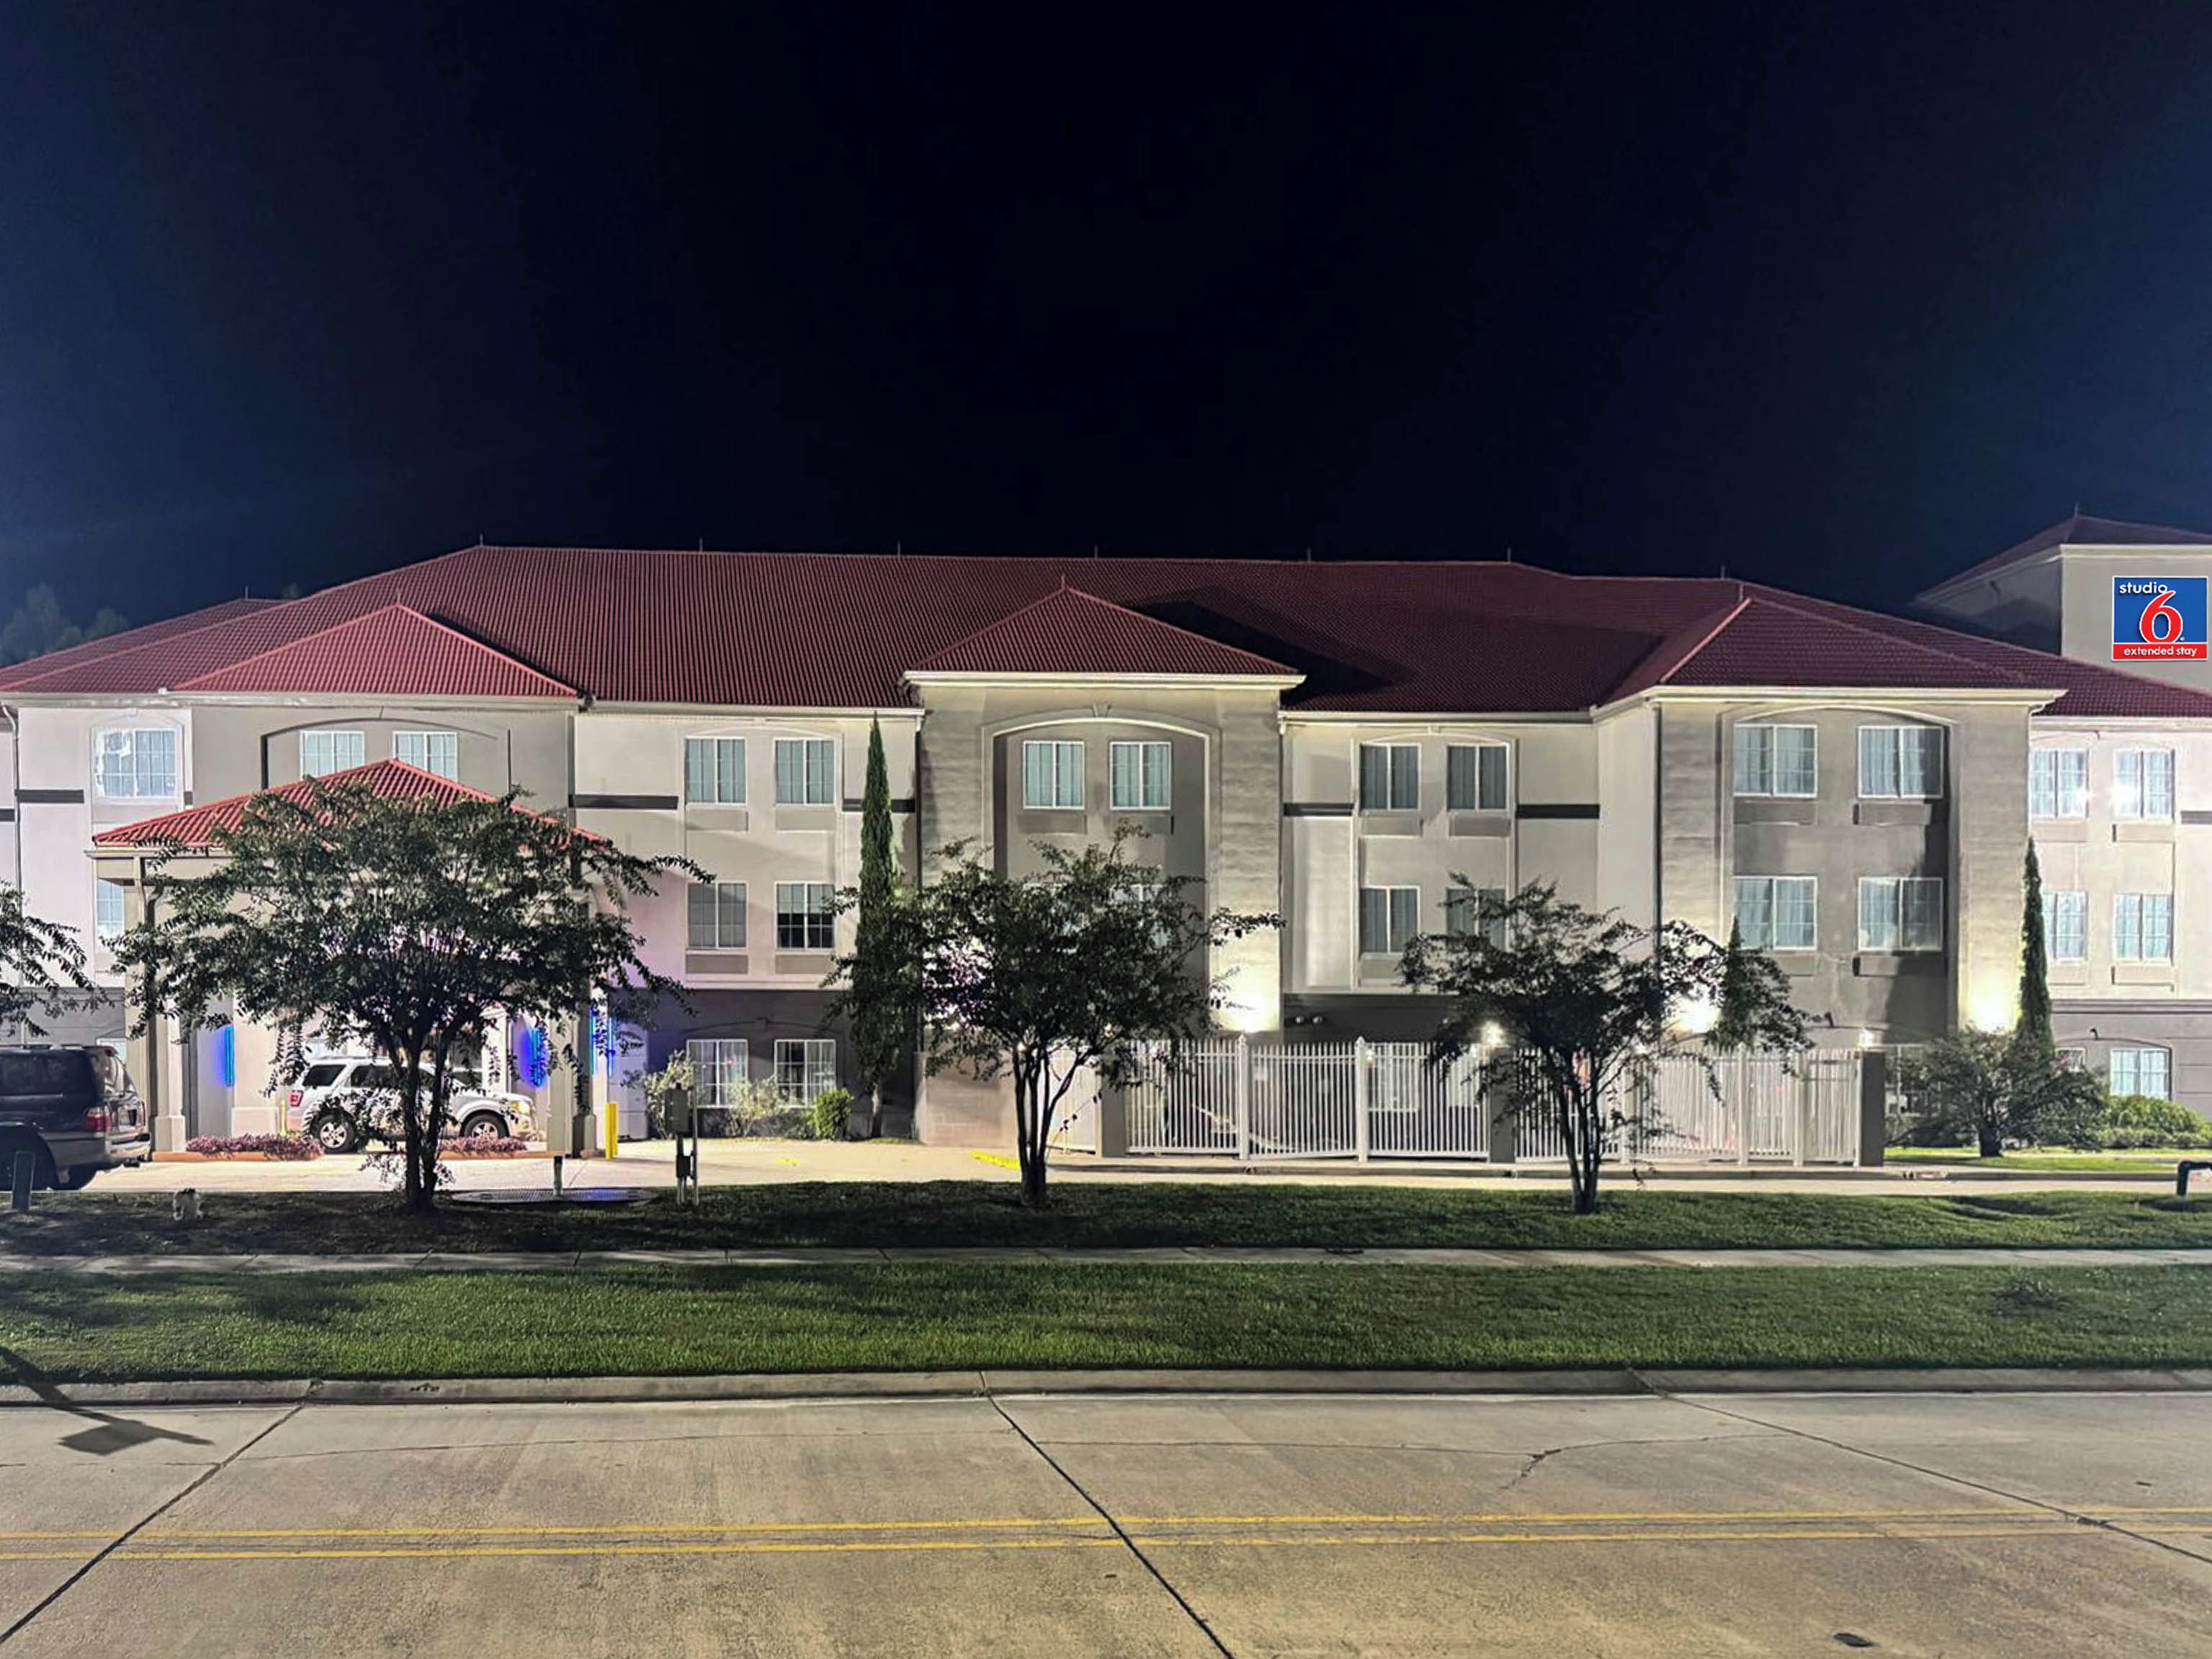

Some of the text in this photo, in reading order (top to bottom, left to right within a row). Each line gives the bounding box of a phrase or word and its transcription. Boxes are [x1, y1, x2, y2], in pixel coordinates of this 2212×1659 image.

[2119, 582, 2167, 593] studio
[2139, 590, 2183, 643] 6
[2123, 647, 2197, 657] extended stay
